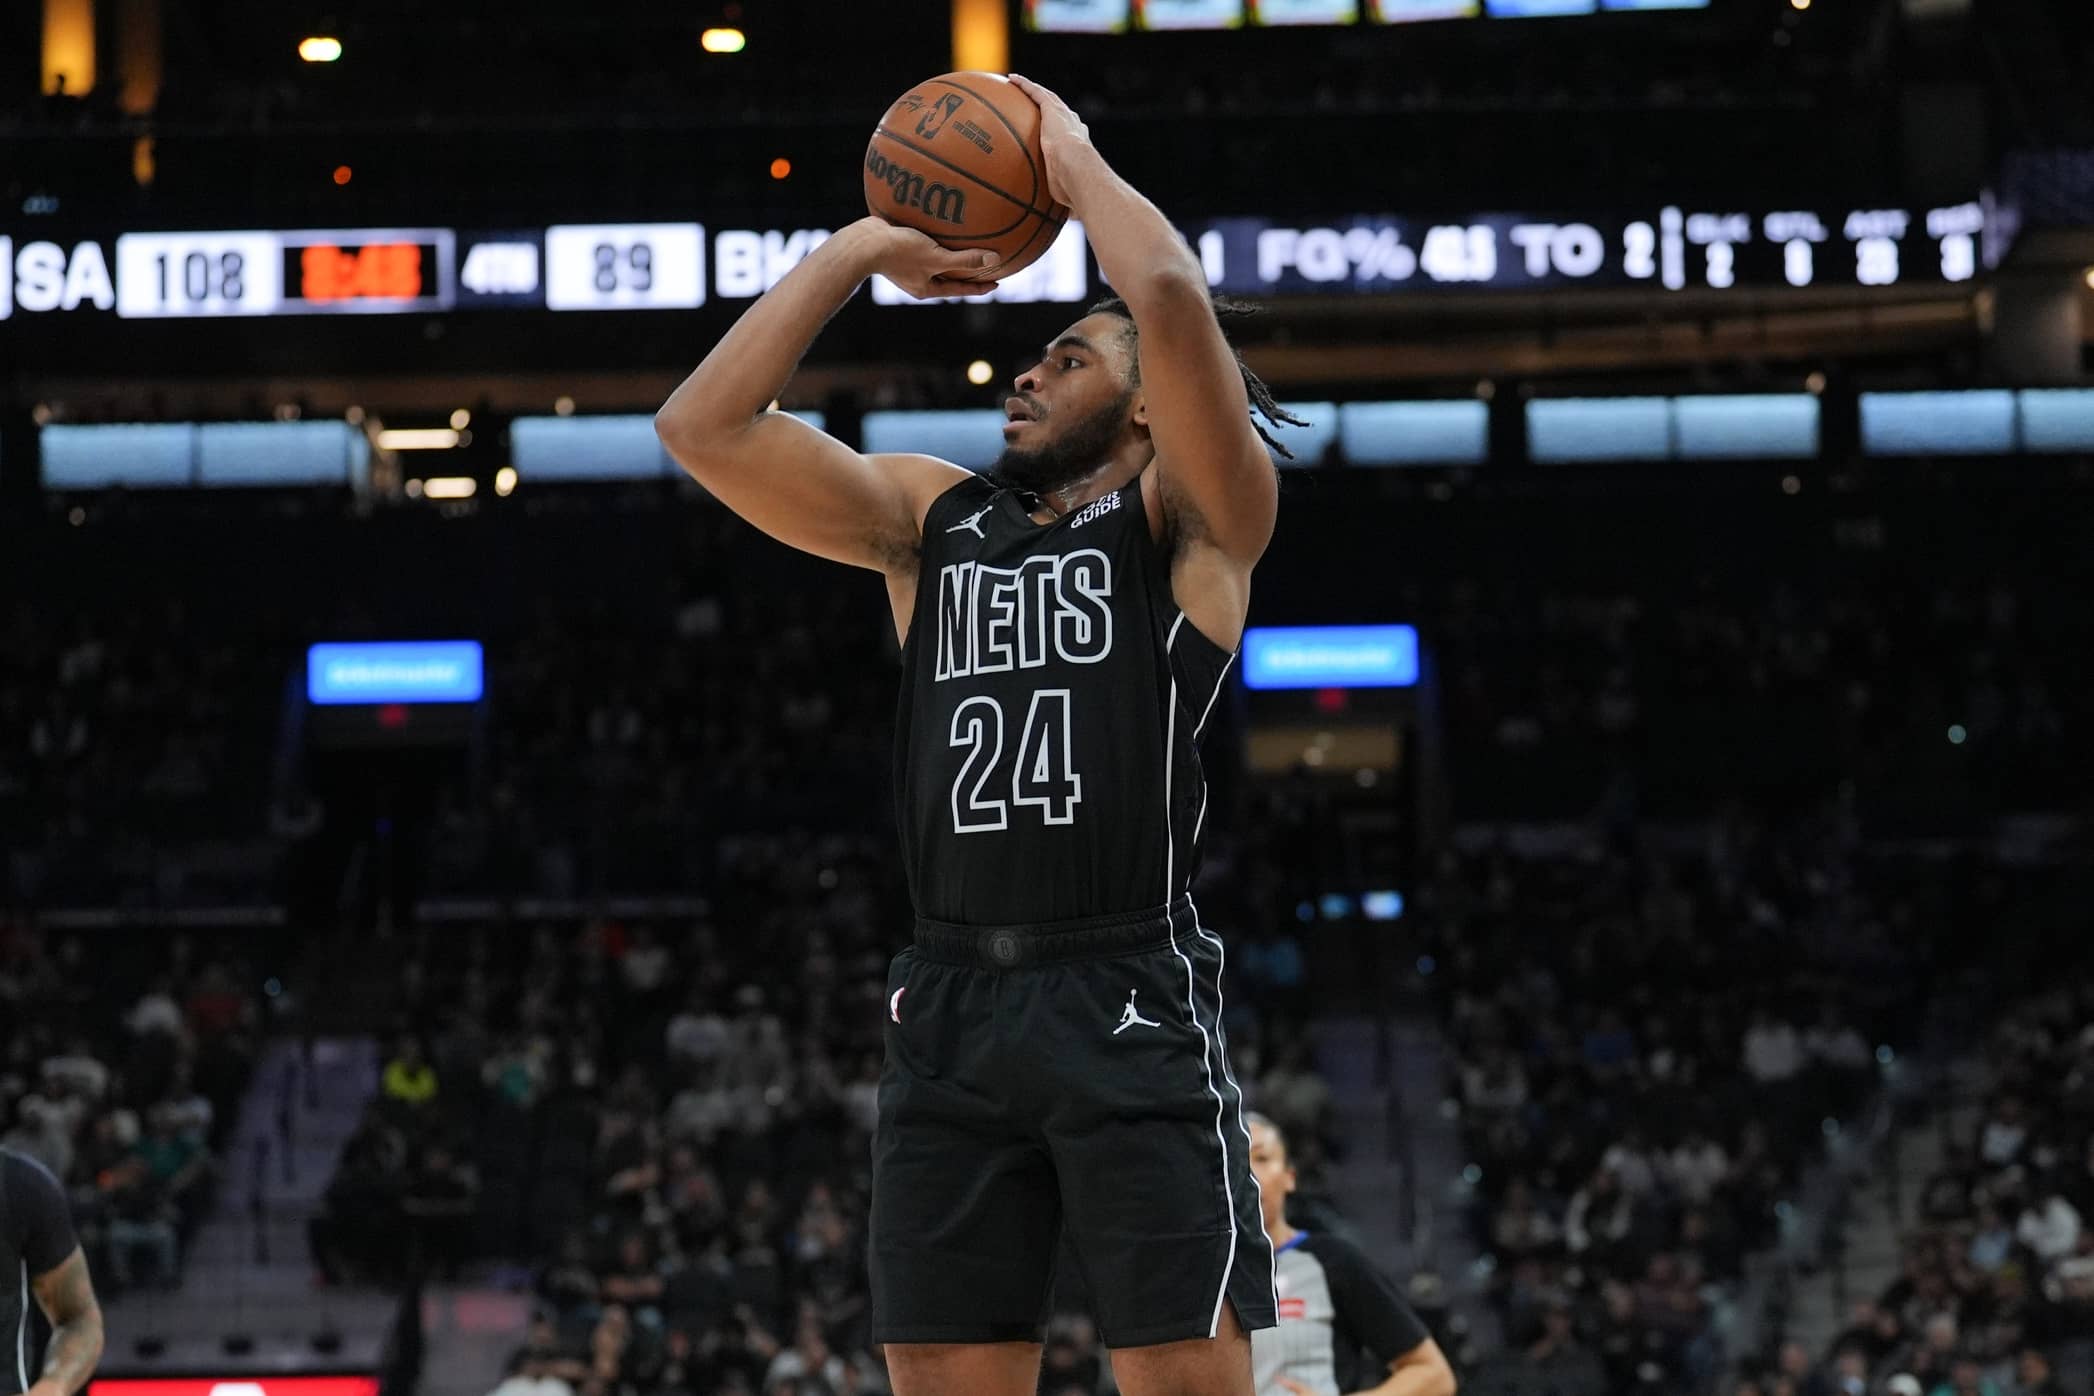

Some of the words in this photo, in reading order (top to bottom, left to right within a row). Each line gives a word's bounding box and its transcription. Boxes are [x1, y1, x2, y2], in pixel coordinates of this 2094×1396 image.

[866, 146, 965, 225] Wilson
[15, 240, 115, 311] SA
[157, 251, 243, 302] 108
[595, 243, 653, 292] 89
[715, 229, 833, 297] BK
[1257, 227, 1417, 283] FG%
[1509, 223, 1605, 278] TO
[1070, 496, 1121, 529] GUIDE
[934, 548, 1113, 682] NETS
[949, 688, 1082, 834] 24
